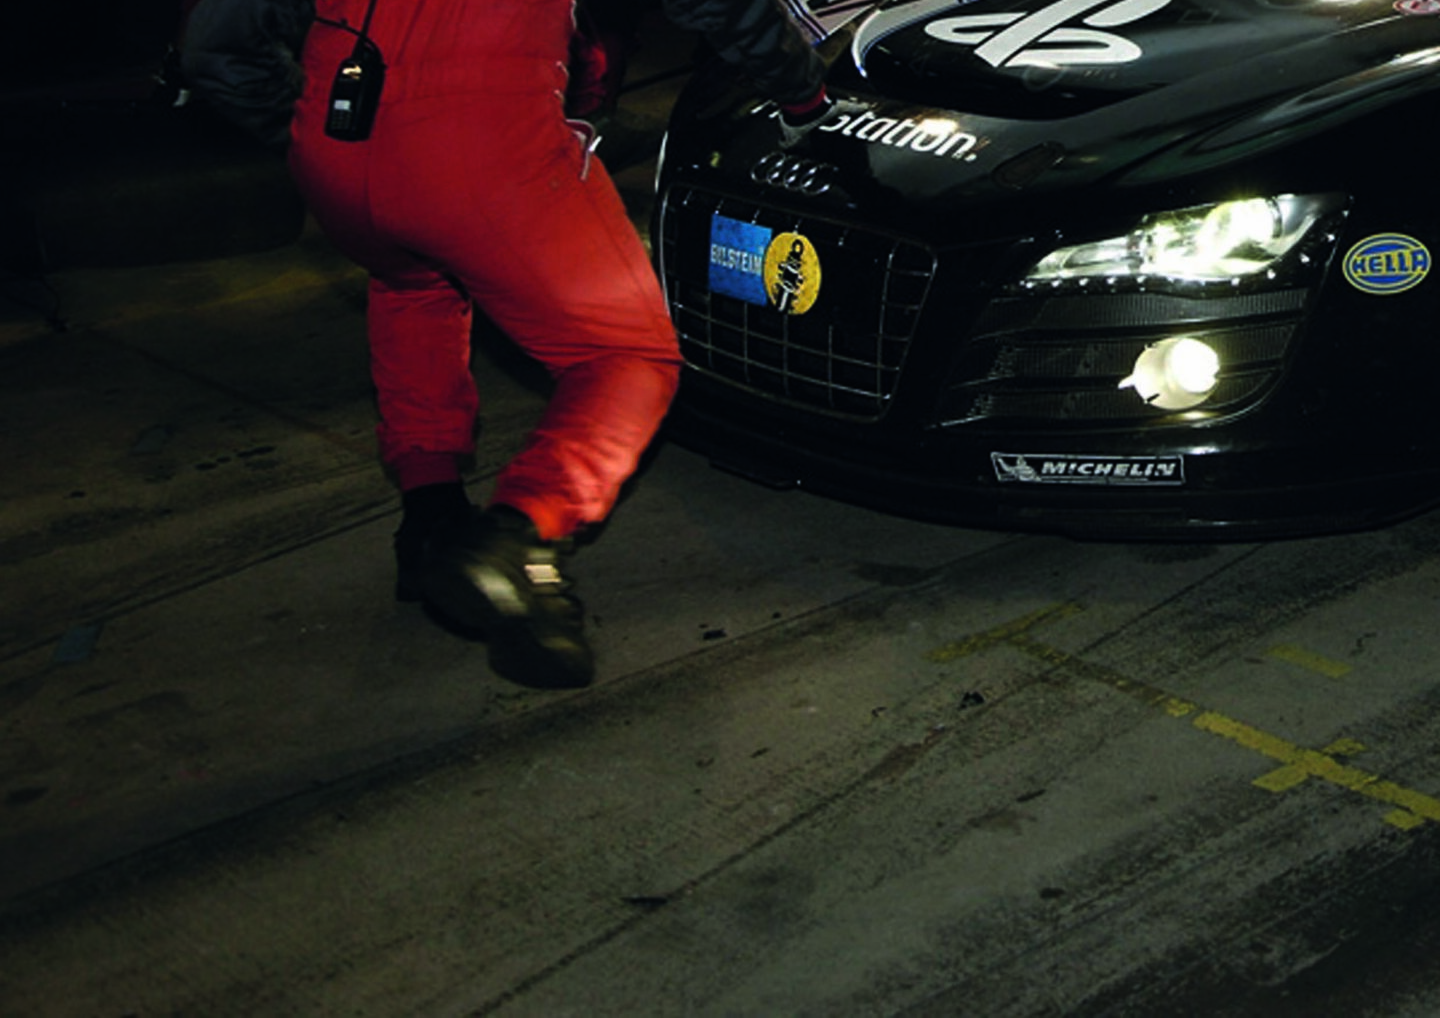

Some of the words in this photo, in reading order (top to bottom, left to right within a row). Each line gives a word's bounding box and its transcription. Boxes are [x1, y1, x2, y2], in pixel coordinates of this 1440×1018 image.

[710, 243, 763, 277] BILSTEIN
[1352, 247, 1429, 274] HELLA
[1041, 460, 1177, 479] MICHELIN
